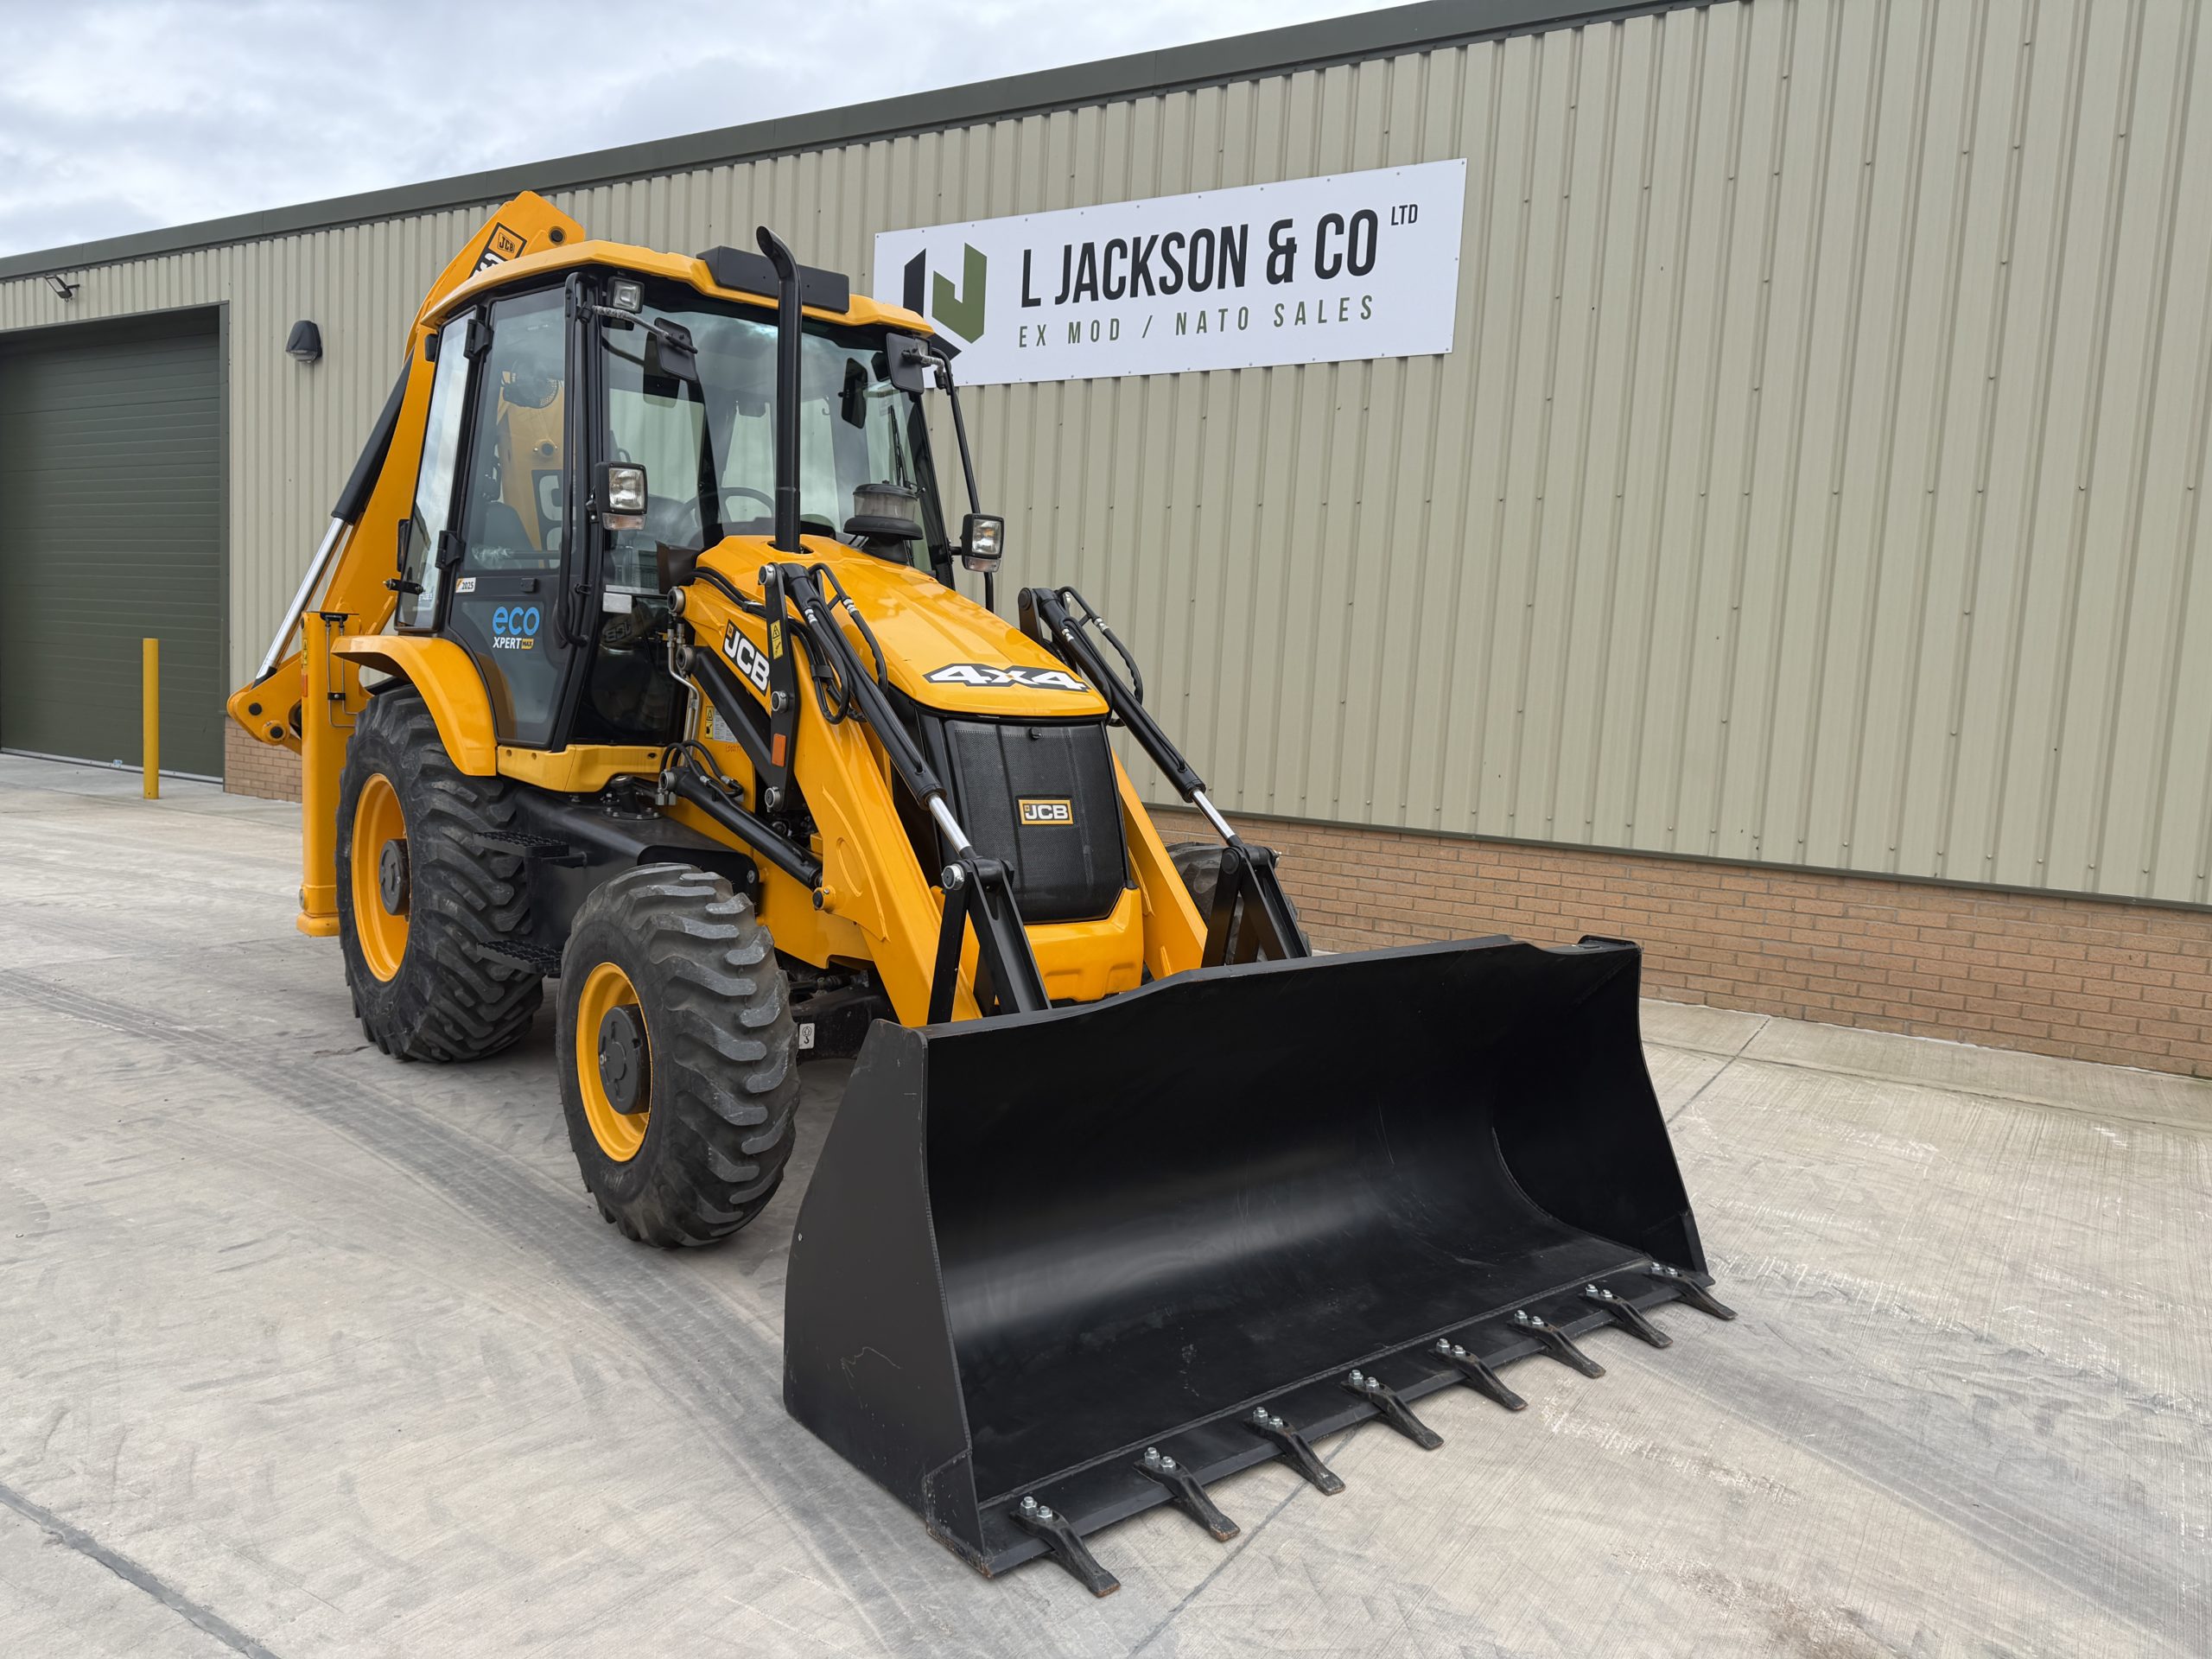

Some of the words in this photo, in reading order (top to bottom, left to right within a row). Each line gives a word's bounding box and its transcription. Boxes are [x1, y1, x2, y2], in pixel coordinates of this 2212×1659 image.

[499, 236, 514, 251] JCB
[1020, 248, 1042, 308] L
[1054, 224, 1249, 305] JACKSON
[1266, 218, 1297, 285] &
[1314, 208, 1378, 280] CO
[1390, 203, 1419, 226] LTD
[1019, 323, 1047, 348] EX
[1067, 317, 1121, 345] MOD
[1175, 306, 1249, 336] NATO
[1273, 295, 1373, 327] SALES
[461, 582, 474, 590] 2025
[493, 607, 540, 635] eco
[493, 637, 522, 649] XPERT
[724, 631, 770, 690] JCB
[1026, 804, 1068, 820] JCB
